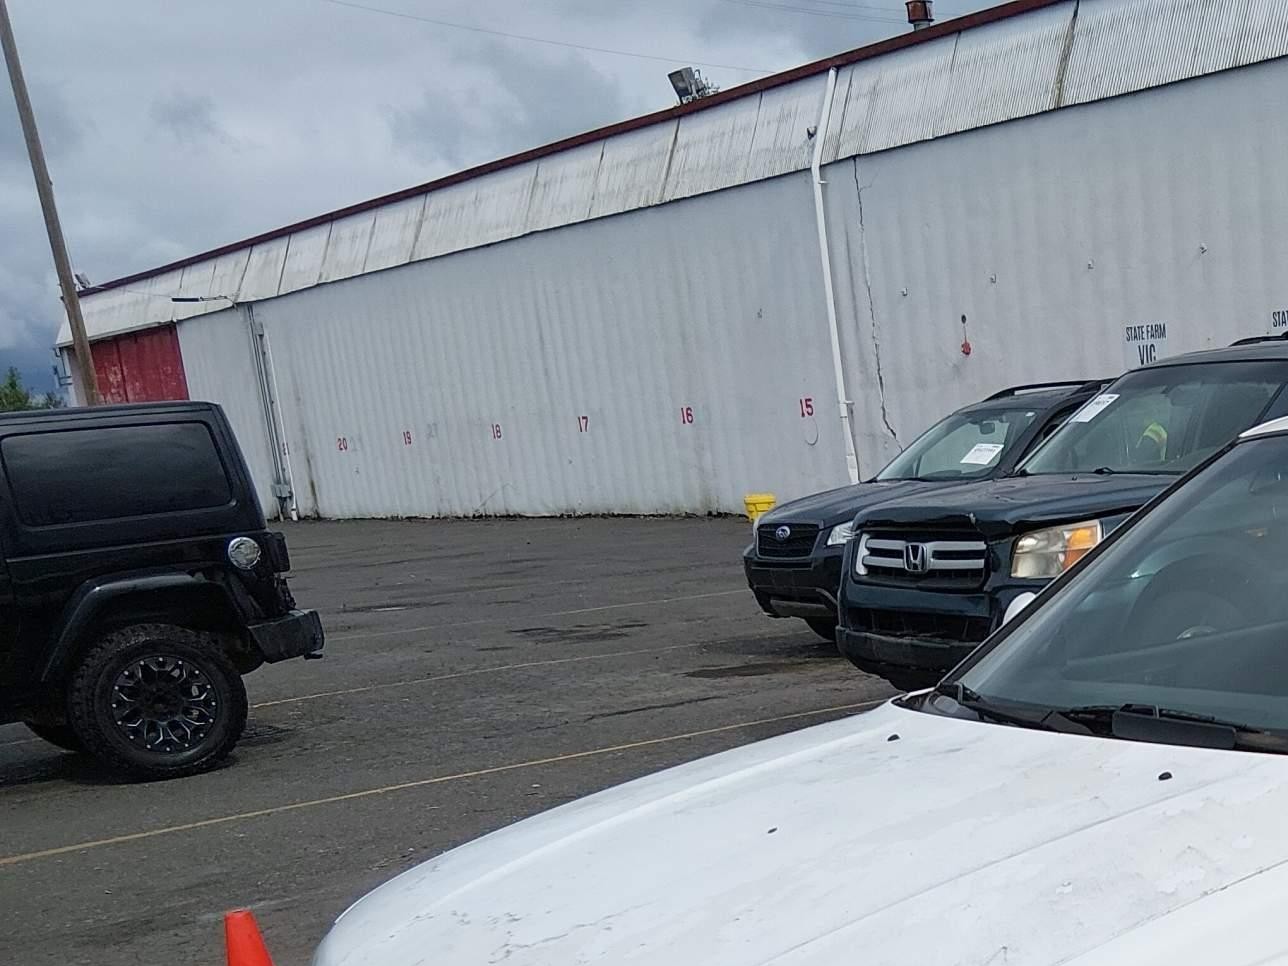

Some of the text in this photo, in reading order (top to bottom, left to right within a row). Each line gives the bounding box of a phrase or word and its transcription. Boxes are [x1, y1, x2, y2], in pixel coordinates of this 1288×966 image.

[1126, 323, 1166, 342] STATE FARM
[1138, 343, 1156, 365] VIC
[680, 407, 694, 424] 16
[800, 398, 814, 417] 15
[491, 423, 502, 439] 18
[577, 416, 589, 432] 17
[337, 437, 348, 451] 20
[403, 430, 412, 445] 19
